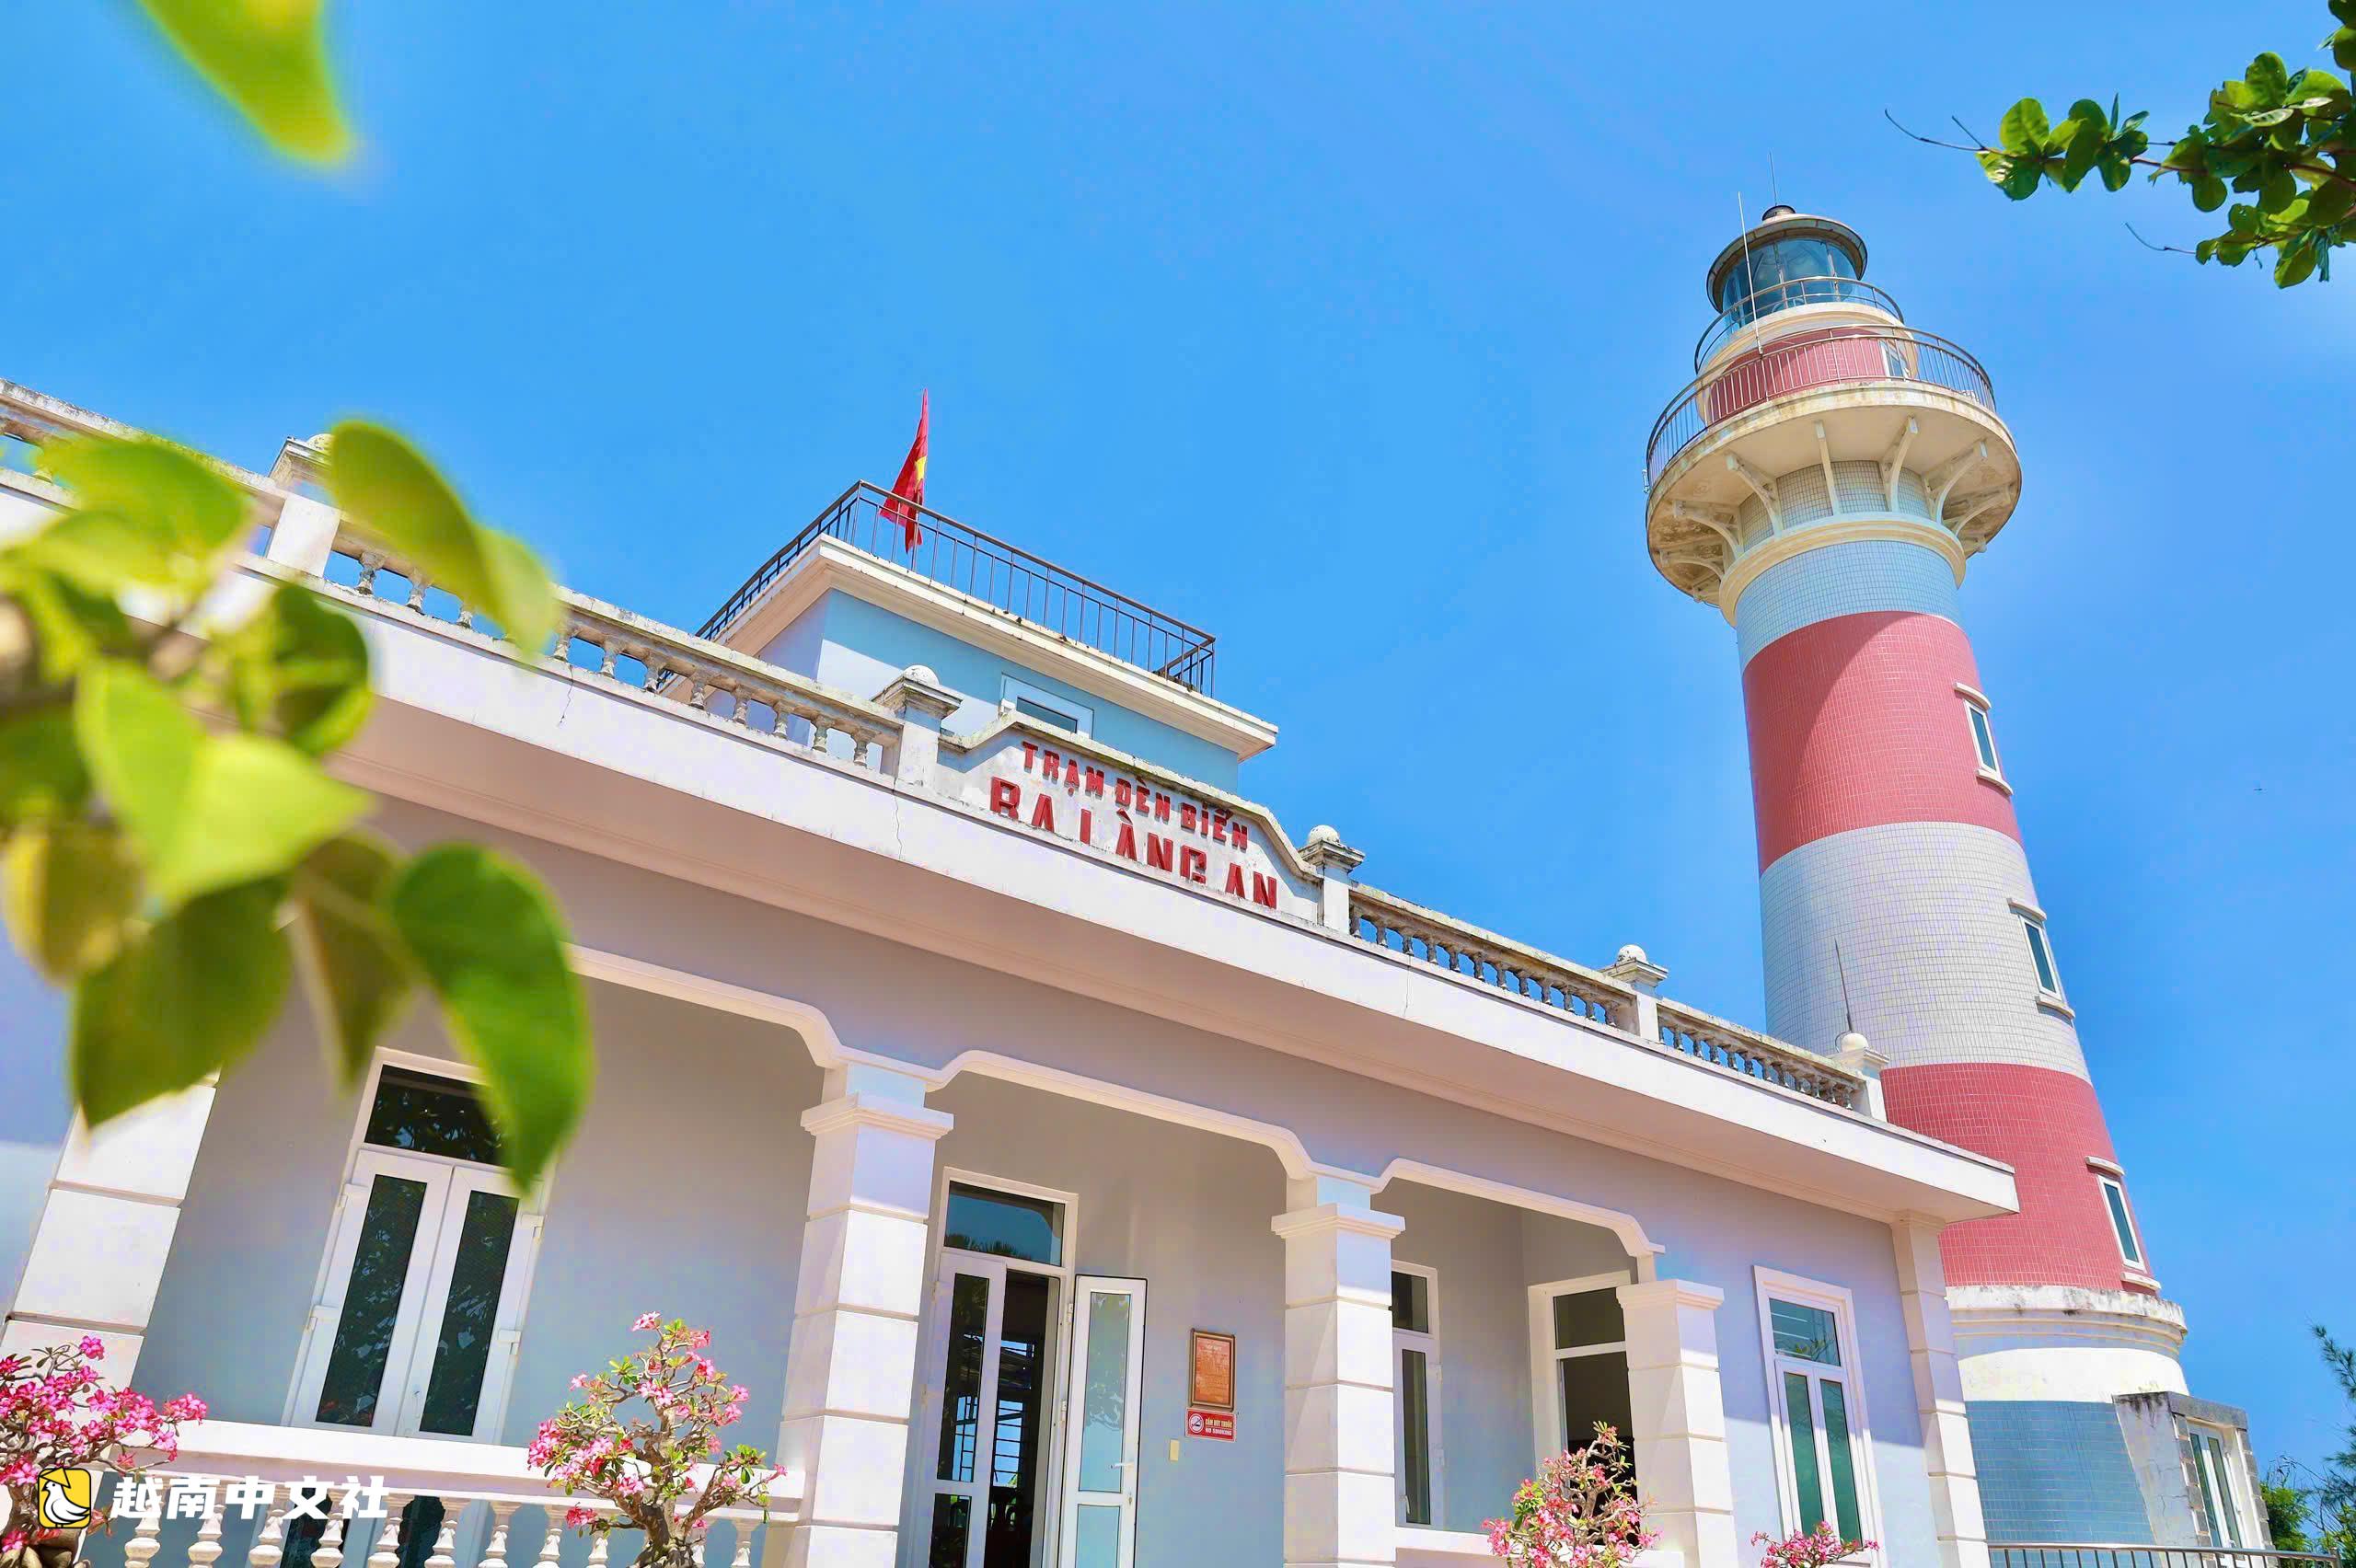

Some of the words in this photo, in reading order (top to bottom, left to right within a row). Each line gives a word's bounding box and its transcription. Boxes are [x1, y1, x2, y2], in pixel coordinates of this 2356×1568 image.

[1022, 741, 1104, 799] TRẠM
[989, 776, 1055, 833] BA
[1225, 862, 1277, 910] AN
